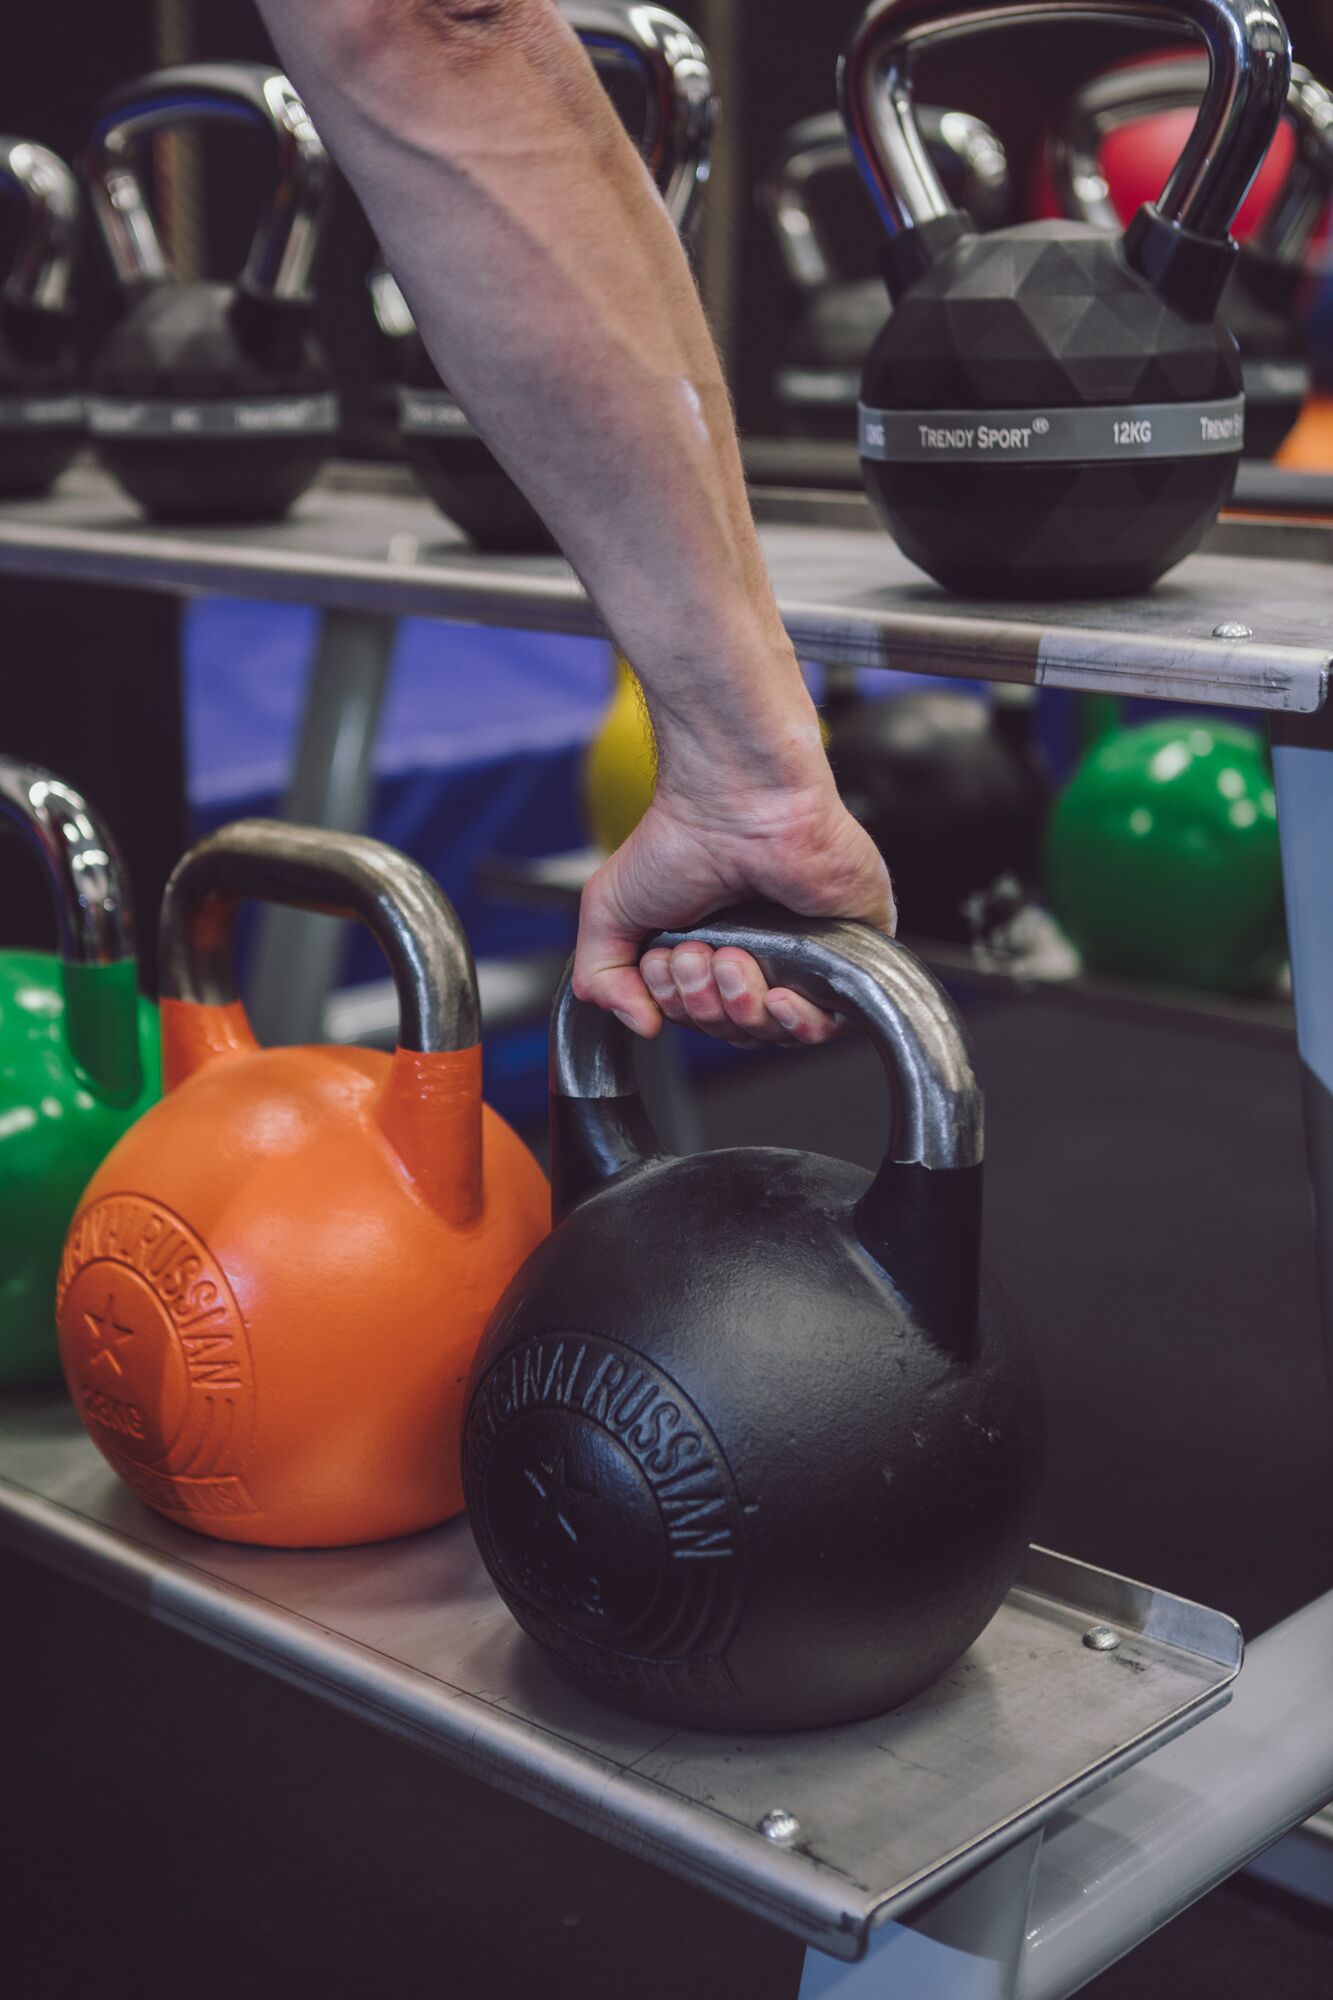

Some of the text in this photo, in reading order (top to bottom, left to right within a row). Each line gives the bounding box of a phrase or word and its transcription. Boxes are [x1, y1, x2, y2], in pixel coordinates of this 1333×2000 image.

[919, 425, 974, 448] TRENDY
[1113, 421, 1152, 444] 12KG
[132, 1207, 242, 1388] RUSSIAN
[582, 1353, 734, 1559] RUSSIAN
